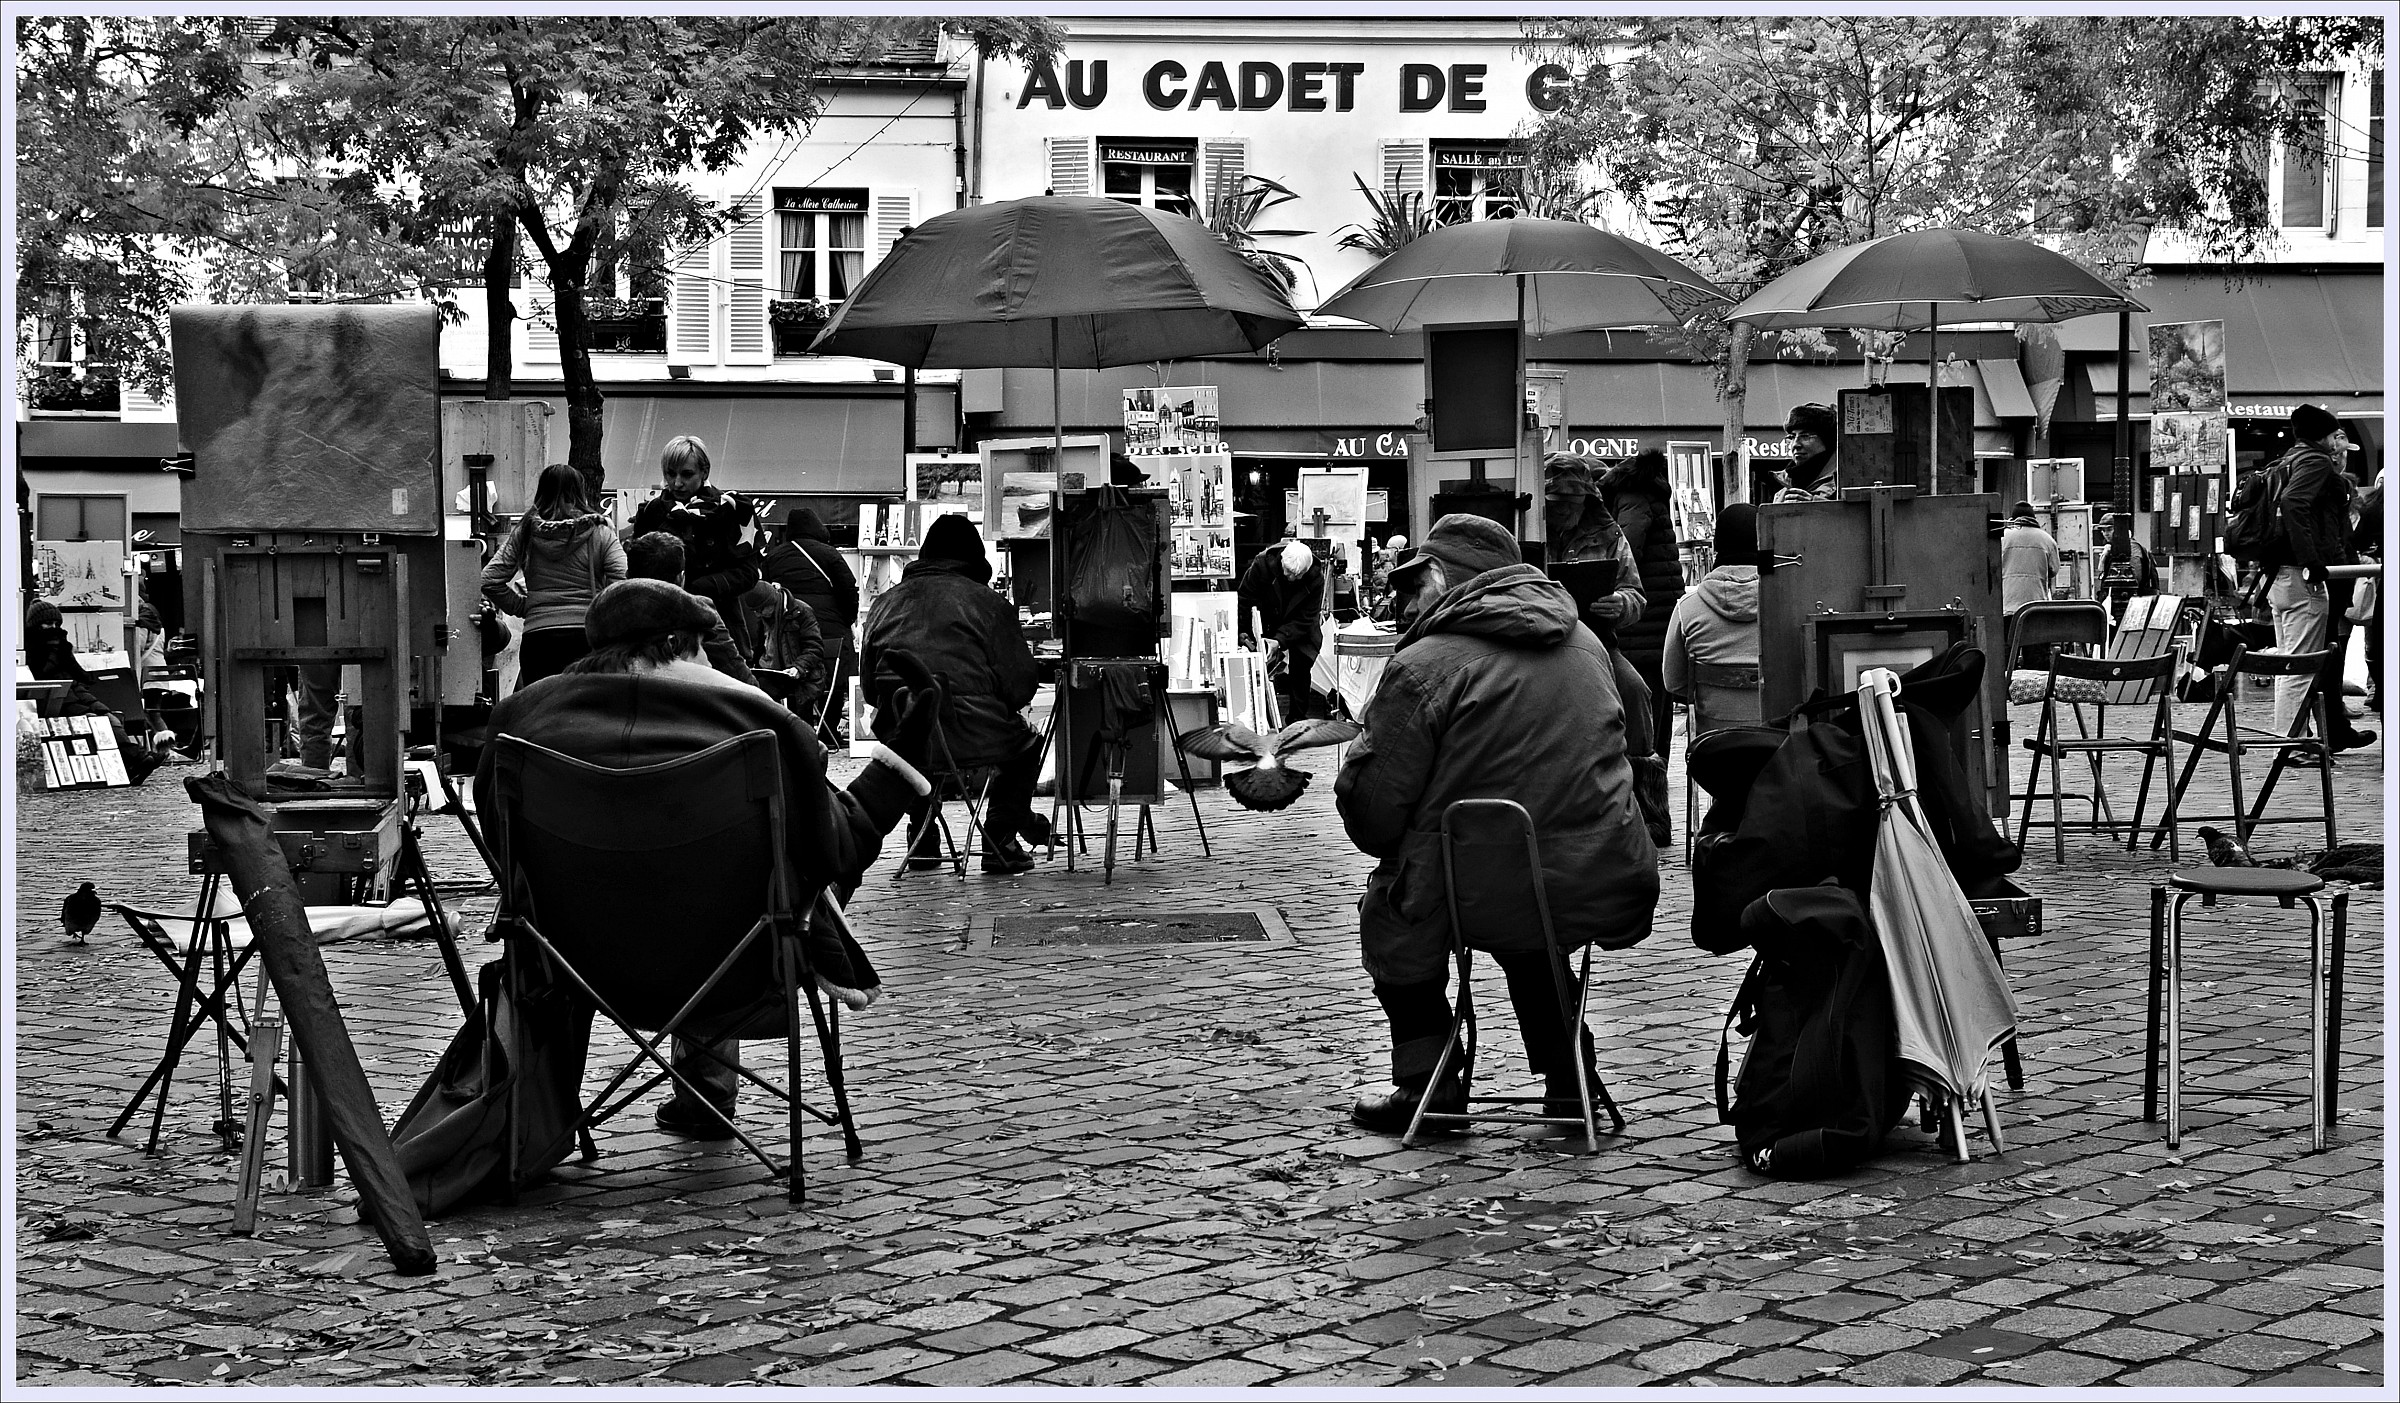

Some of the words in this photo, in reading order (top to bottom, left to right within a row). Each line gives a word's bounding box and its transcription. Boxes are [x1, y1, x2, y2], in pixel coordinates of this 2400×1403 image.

[1016, 60, 1108, 110] AU
[1142, 60, 1365, 112] CADET
[1399, 63, 1488, 114] DE
[1107, 148, 1187, 162] RESTAURANT
[1442, 153, 1483, 166] SALLE
[783, 196, 796, 208] La
[797, 196, 820, 209] Mère
[821, 196, 859, 210] Catherine
[1332, 437, 1367, 457] AU
